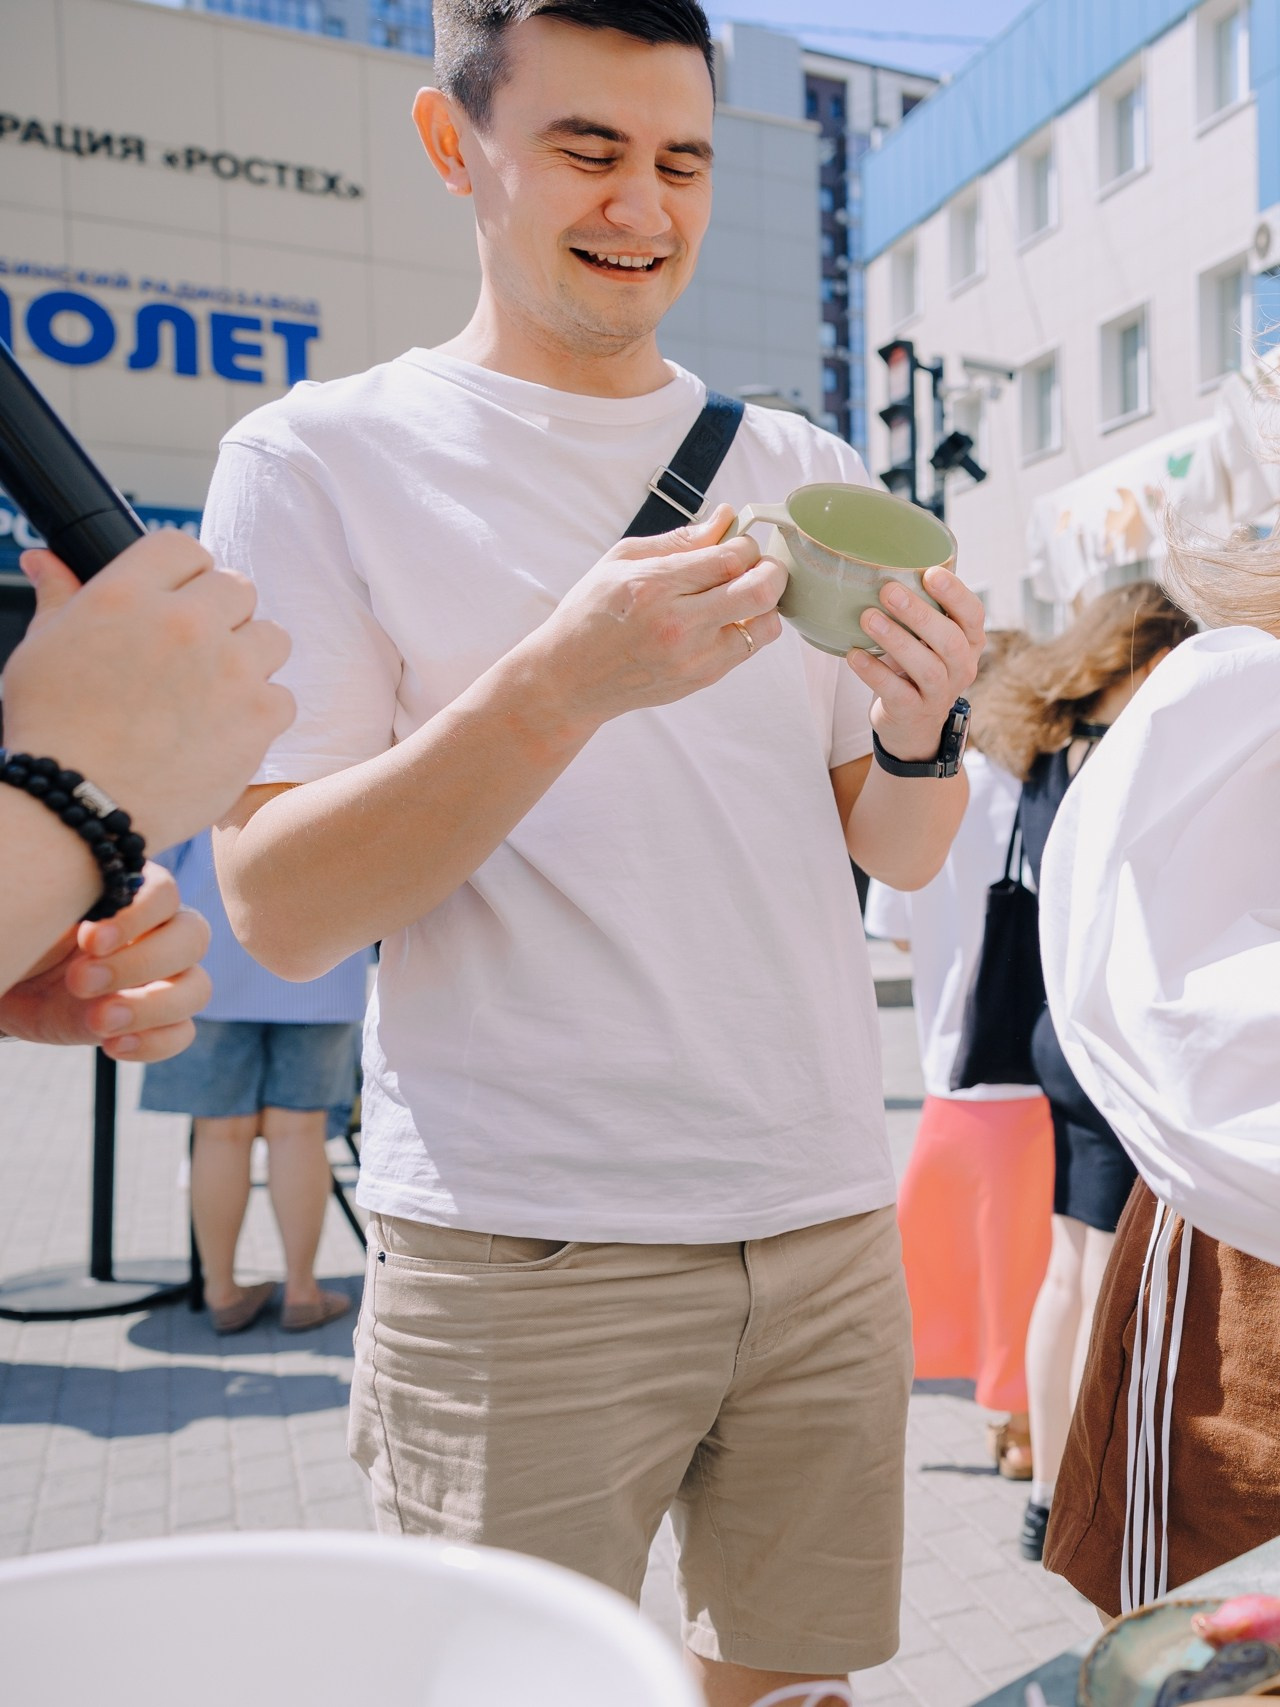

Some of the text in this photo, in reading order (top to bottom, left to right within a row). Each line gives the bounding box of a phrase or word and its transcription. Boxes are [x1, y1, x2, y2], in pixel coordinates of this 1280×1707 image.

[163, 145, 364, 200] «РОСТЕХ»
[140, 276, 320, 316] РАДИОЗАВОД
[0, 286, 319, 387] ОЛЕТ
